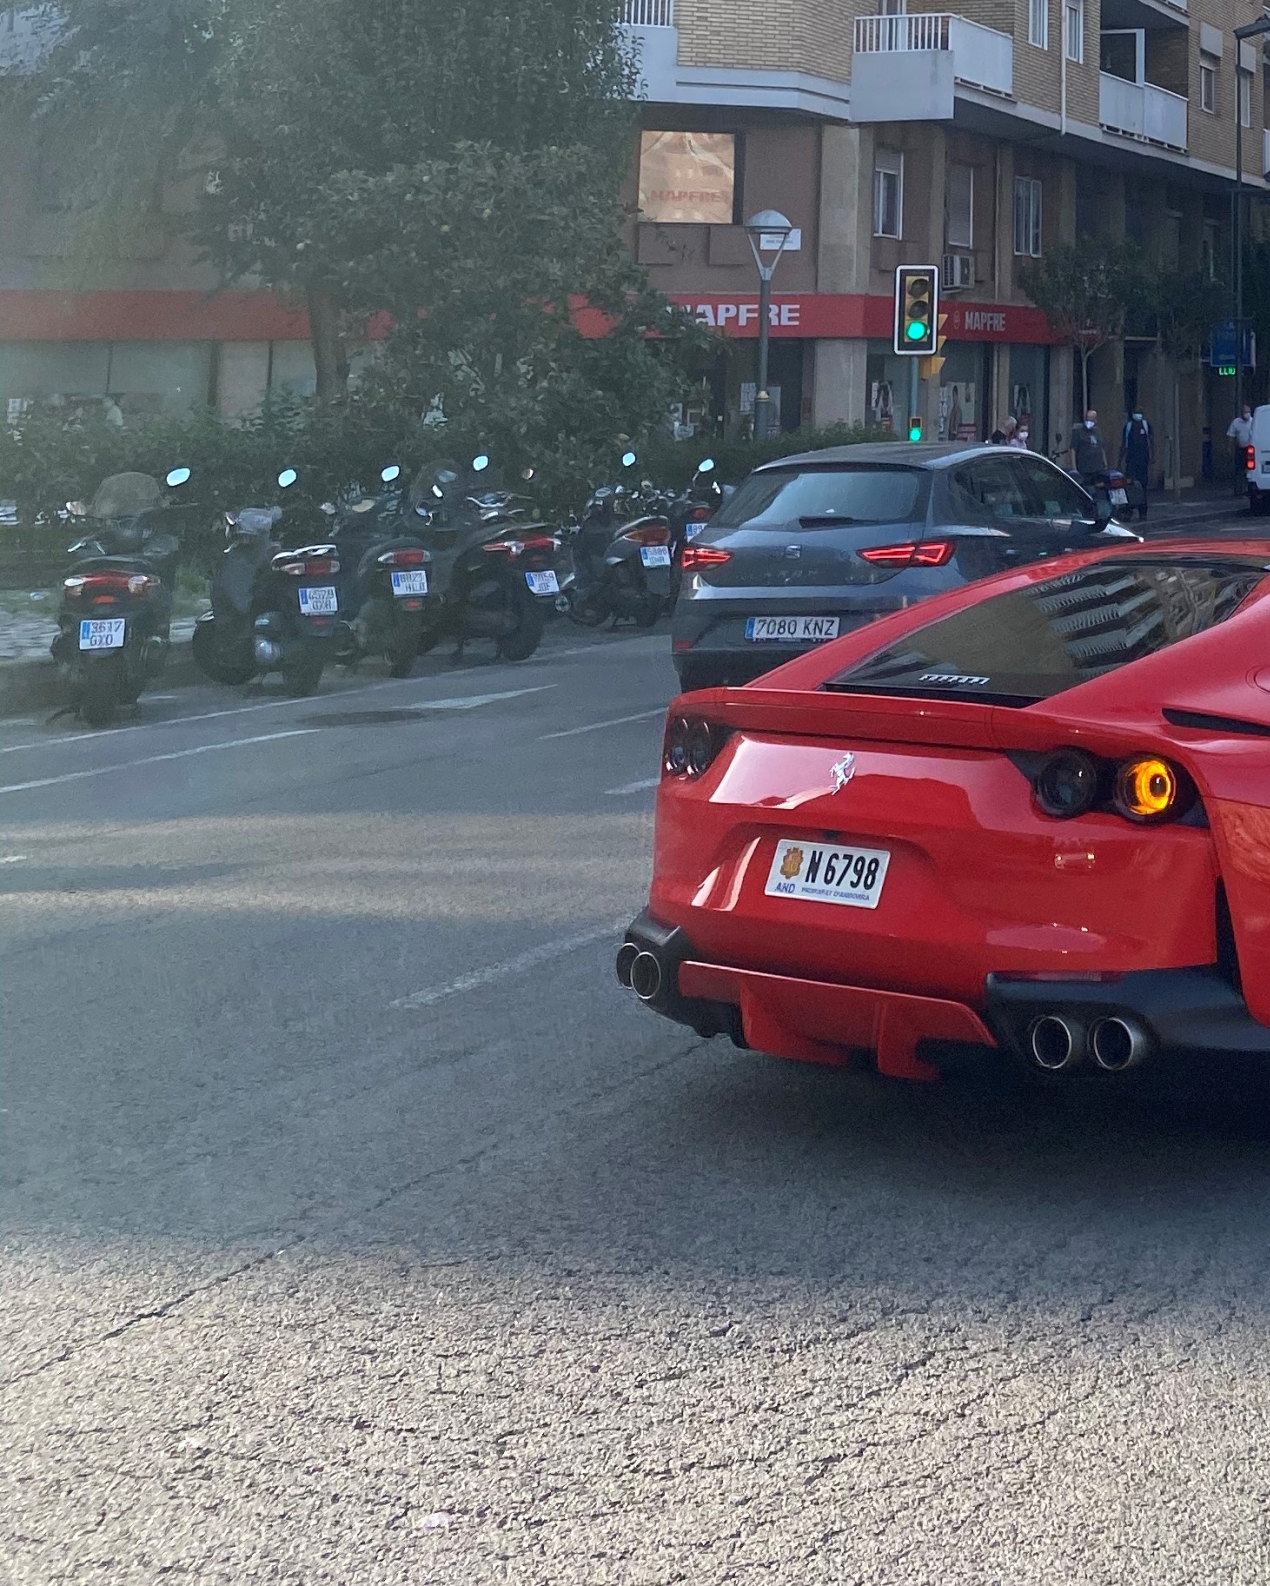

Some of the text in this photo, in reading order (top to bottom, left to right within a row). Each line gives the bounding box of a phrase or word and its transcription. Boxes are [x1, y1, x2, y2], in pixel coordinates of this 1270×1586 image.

[666, 304, 800, 326] APFRE
[964, 310, 1006, 332] MAPFRE
[755, 619, 835, 636] 7080 KNZ
[805, 850, 880, 890] N 6798
[775, 882, 796, 894] AND
